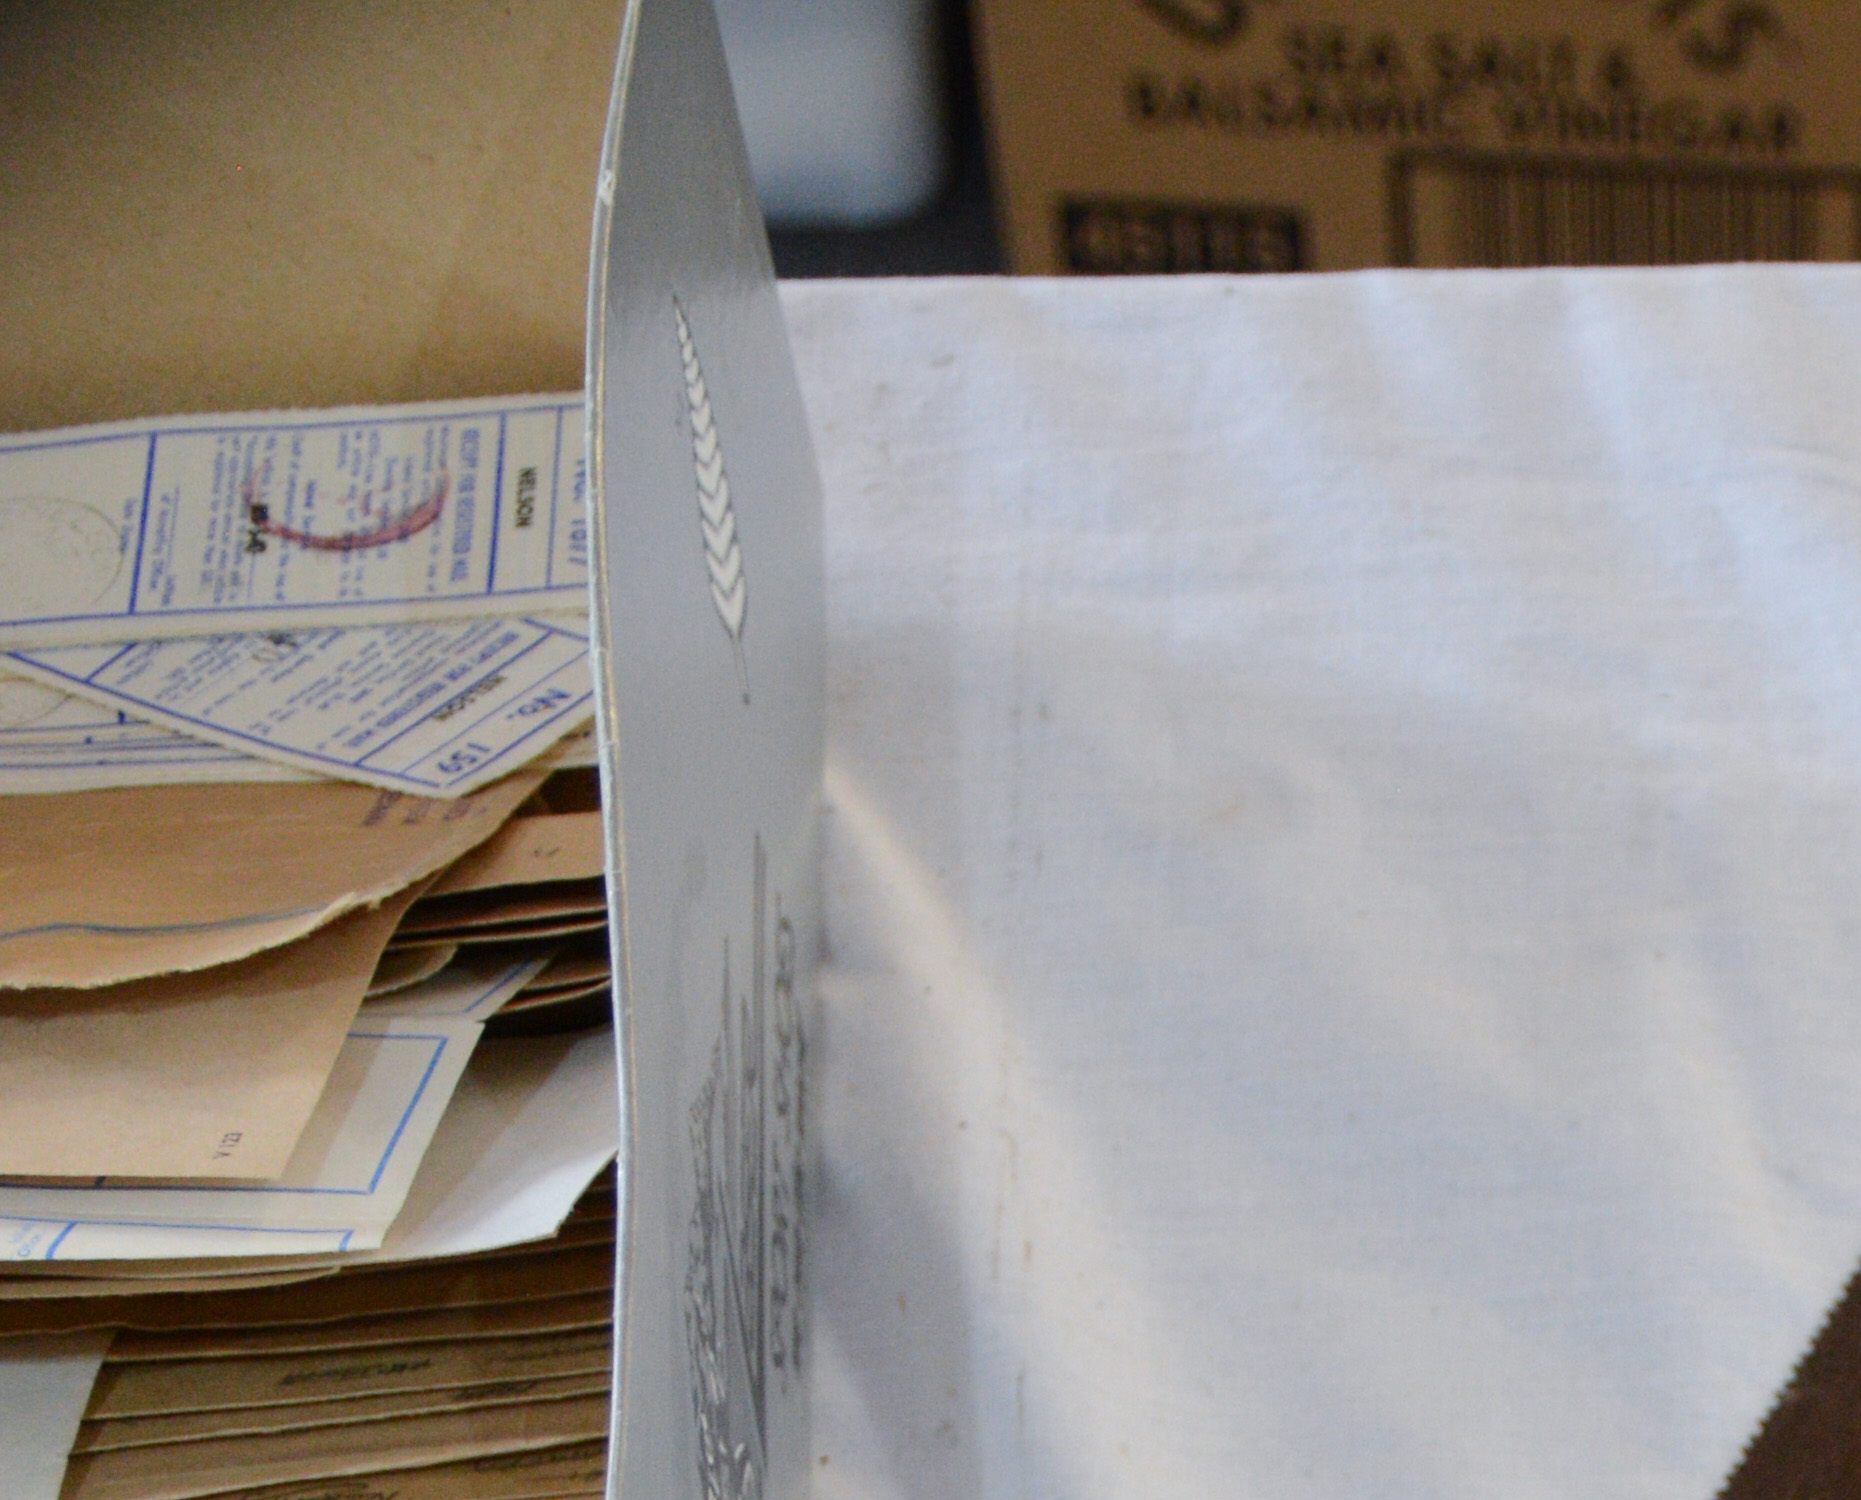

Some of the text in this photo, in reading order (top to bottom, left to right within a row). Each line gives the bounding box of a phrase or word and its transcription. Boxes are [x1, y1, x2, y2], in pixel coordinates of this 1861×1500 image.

[1284, 22, 1400, 76] SEA
[1428, 30, 1577, 92] SALT
[1125, 68, 1802, 153] BALSAMIC VINEGAR
[515, 467, 537, 528] NELSON
[438, 688, 571, 773] No. 159
